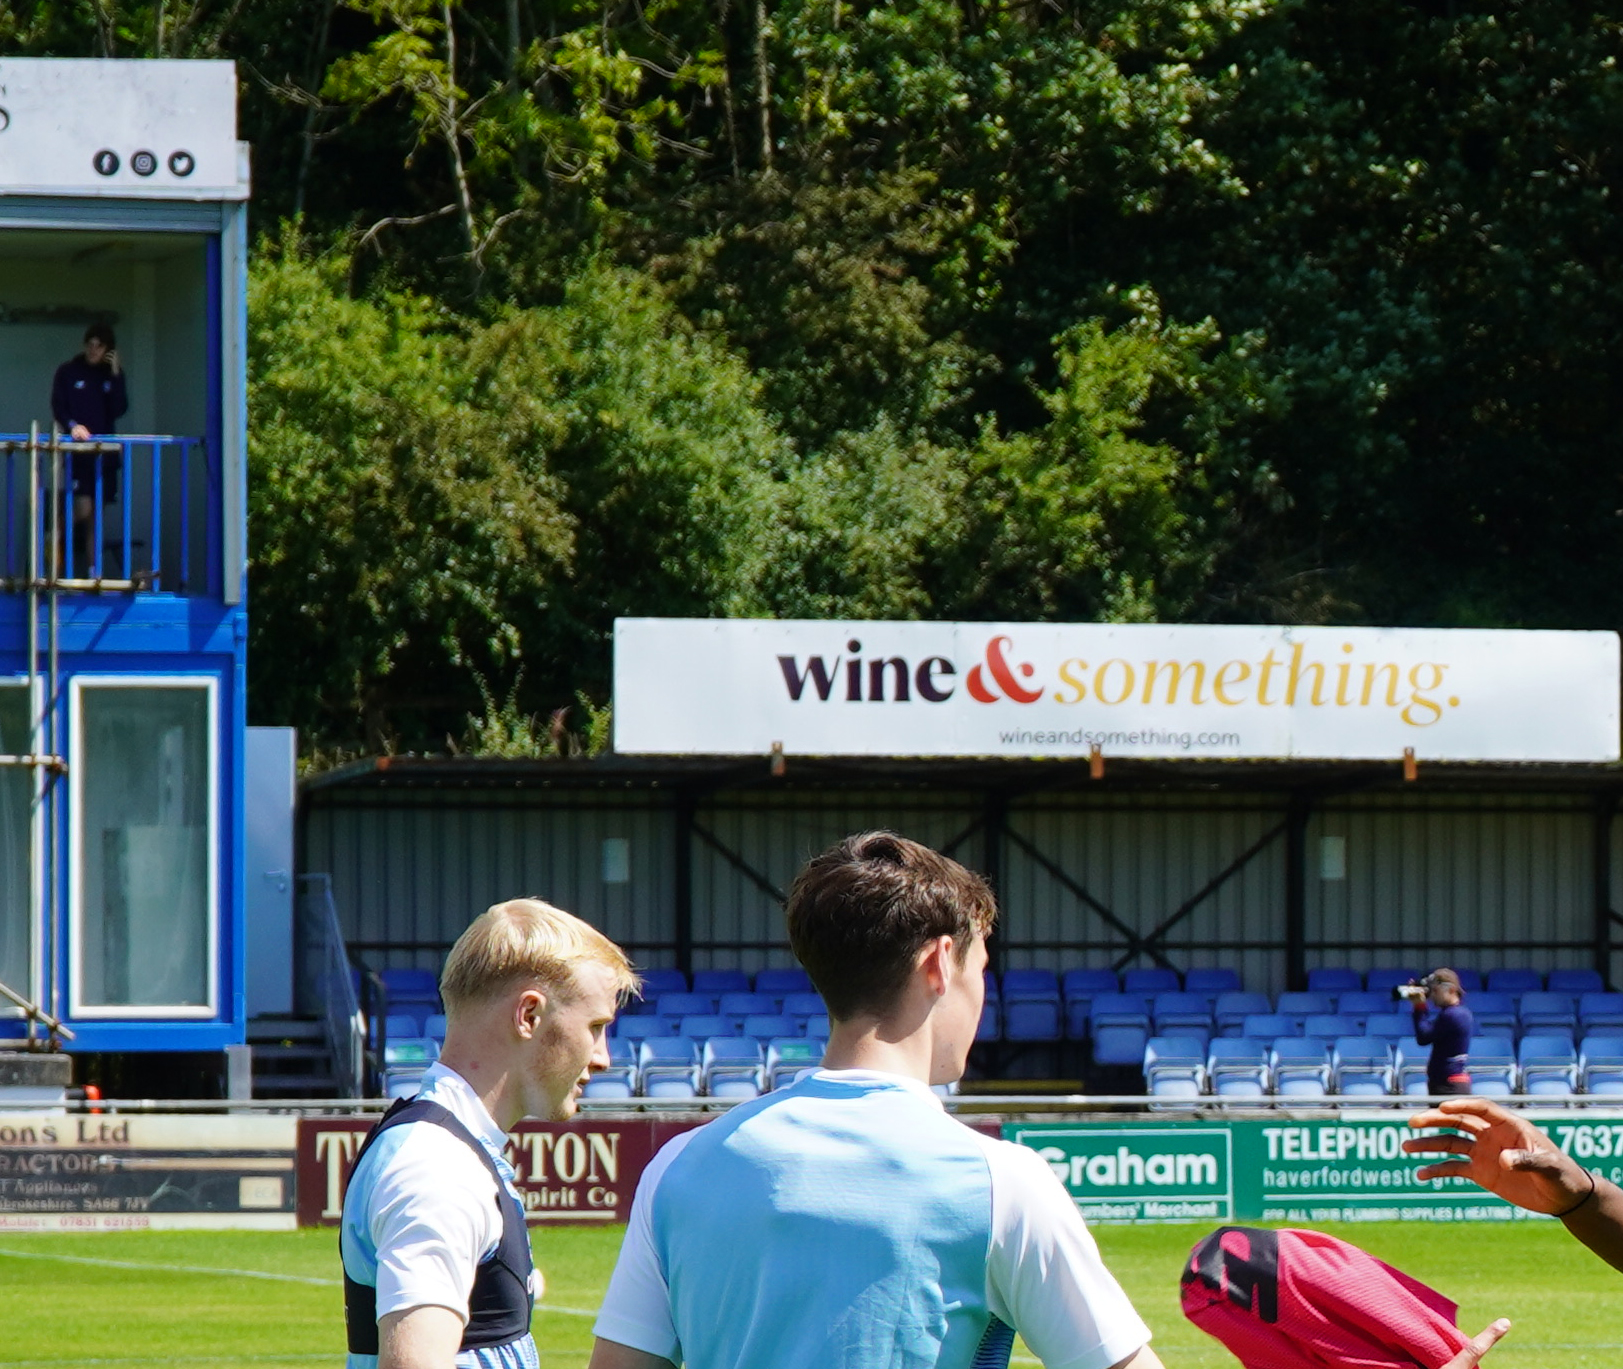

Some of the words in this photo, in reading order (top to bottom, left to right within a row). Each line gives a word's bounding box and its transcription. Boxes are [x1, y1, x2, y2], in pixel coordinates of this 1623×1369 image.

[999, 727, 1241, 751] wineandsomething.com
[76, 1117, 130, 1143] Ltd
[1038, 1146, 1218, 1187] Graham
[587, 1186, 618, 1208] Co
